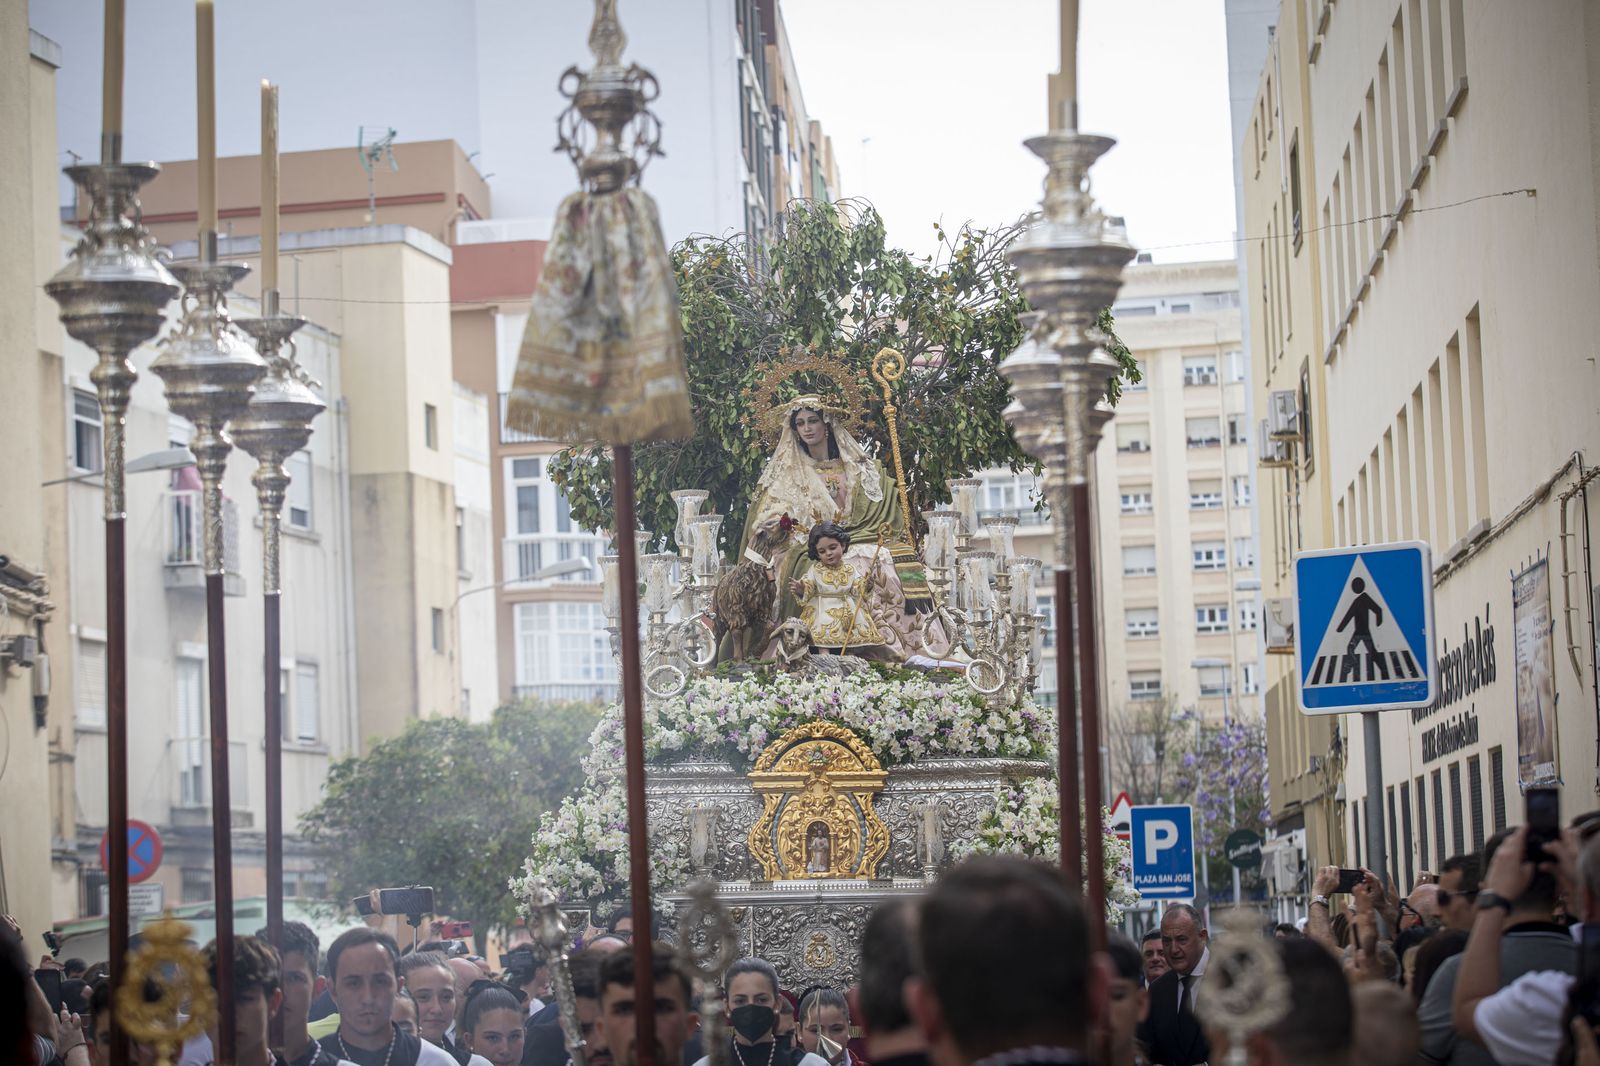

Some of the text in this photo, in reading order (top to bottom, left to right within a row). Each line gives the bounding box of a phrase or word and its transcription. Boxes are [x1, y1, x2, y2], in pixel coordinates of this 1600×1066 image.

[1463, 622, 1476, 696] de
[1475, 602, 1496, 690] Asís
[1144, 819, 1178, 865] P
[1135, 873, 1191, 884] PLAZA SAN JOSE
